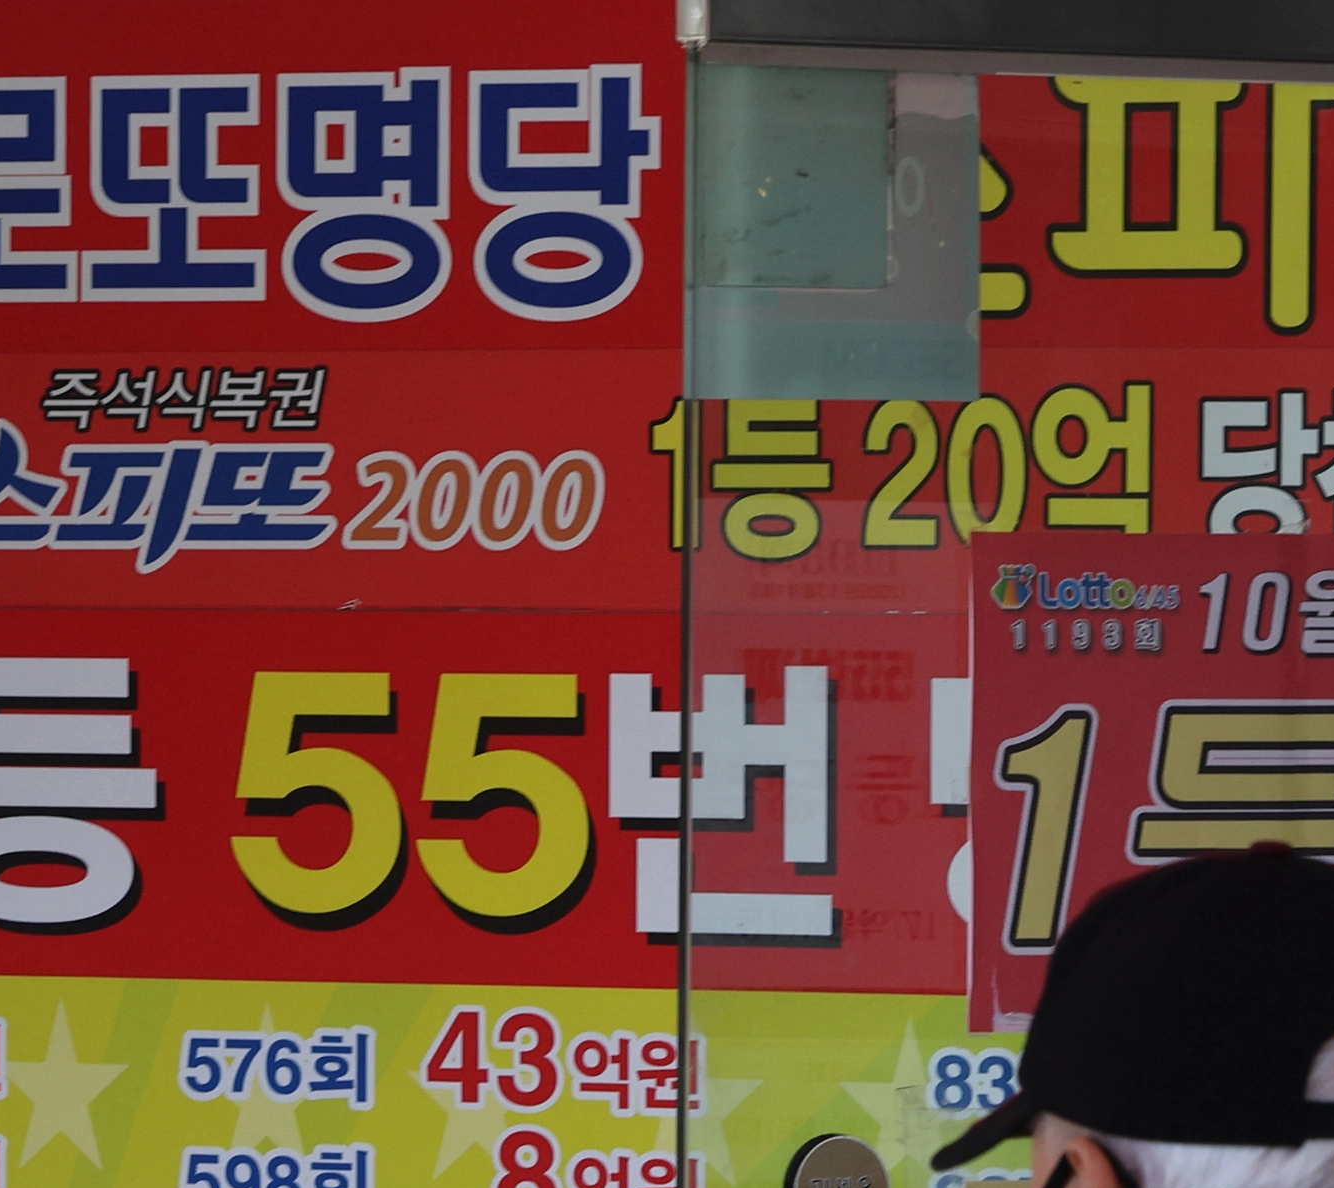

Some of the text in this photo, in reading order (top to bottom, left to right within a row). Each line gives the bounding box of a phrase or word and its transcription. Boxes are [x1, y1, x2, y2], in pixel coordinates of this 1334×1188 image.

[43, 367, 327, 432] 즉석식복권
[341, 450, 605, 550] 2000
[649, 397, 833, 562] 1등
[861, 384, 1154, 548] 20억
[1010, 618, 1163, 651] 1193회
[181, 1030, 372, 1106] 576회
